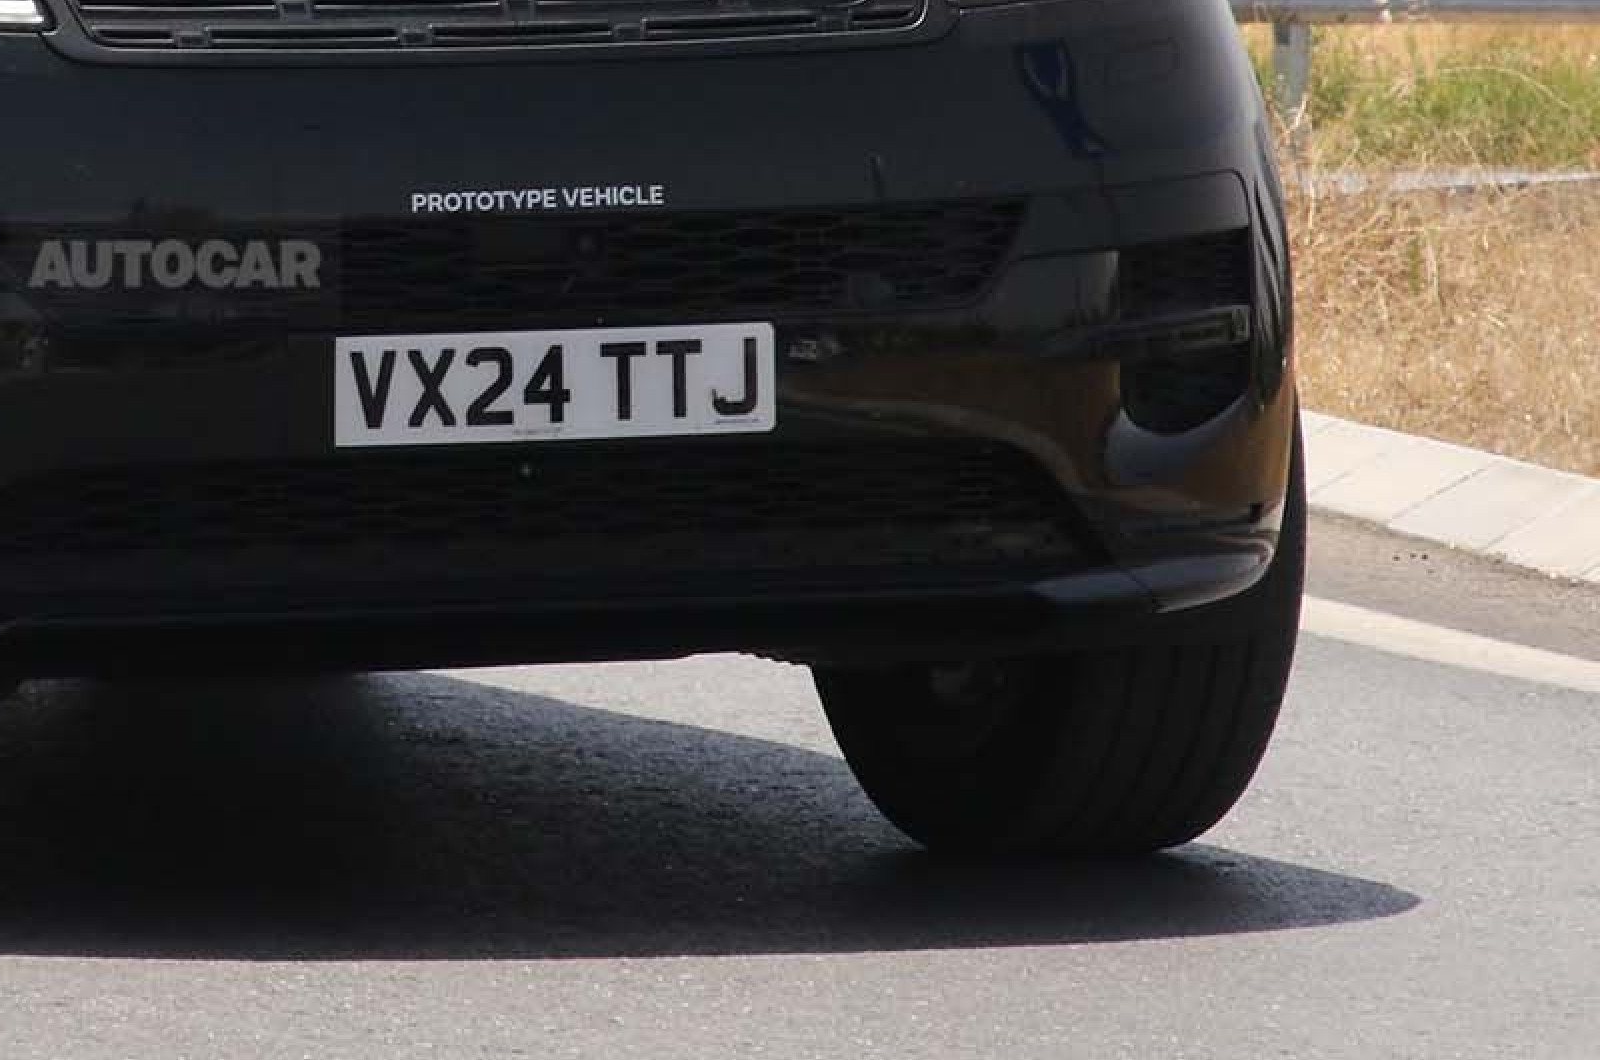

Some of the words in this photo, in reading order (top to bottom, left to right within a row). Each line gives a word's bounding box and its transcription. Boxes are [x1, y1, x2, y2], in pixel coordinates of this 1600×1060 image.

[411, 188, 558, 213] PROTOTYPE
[562, 184, 665, 208] VEHICLE
[349, 344, 571, 430] VX24
[599, 336, 758, 421] TTJ
